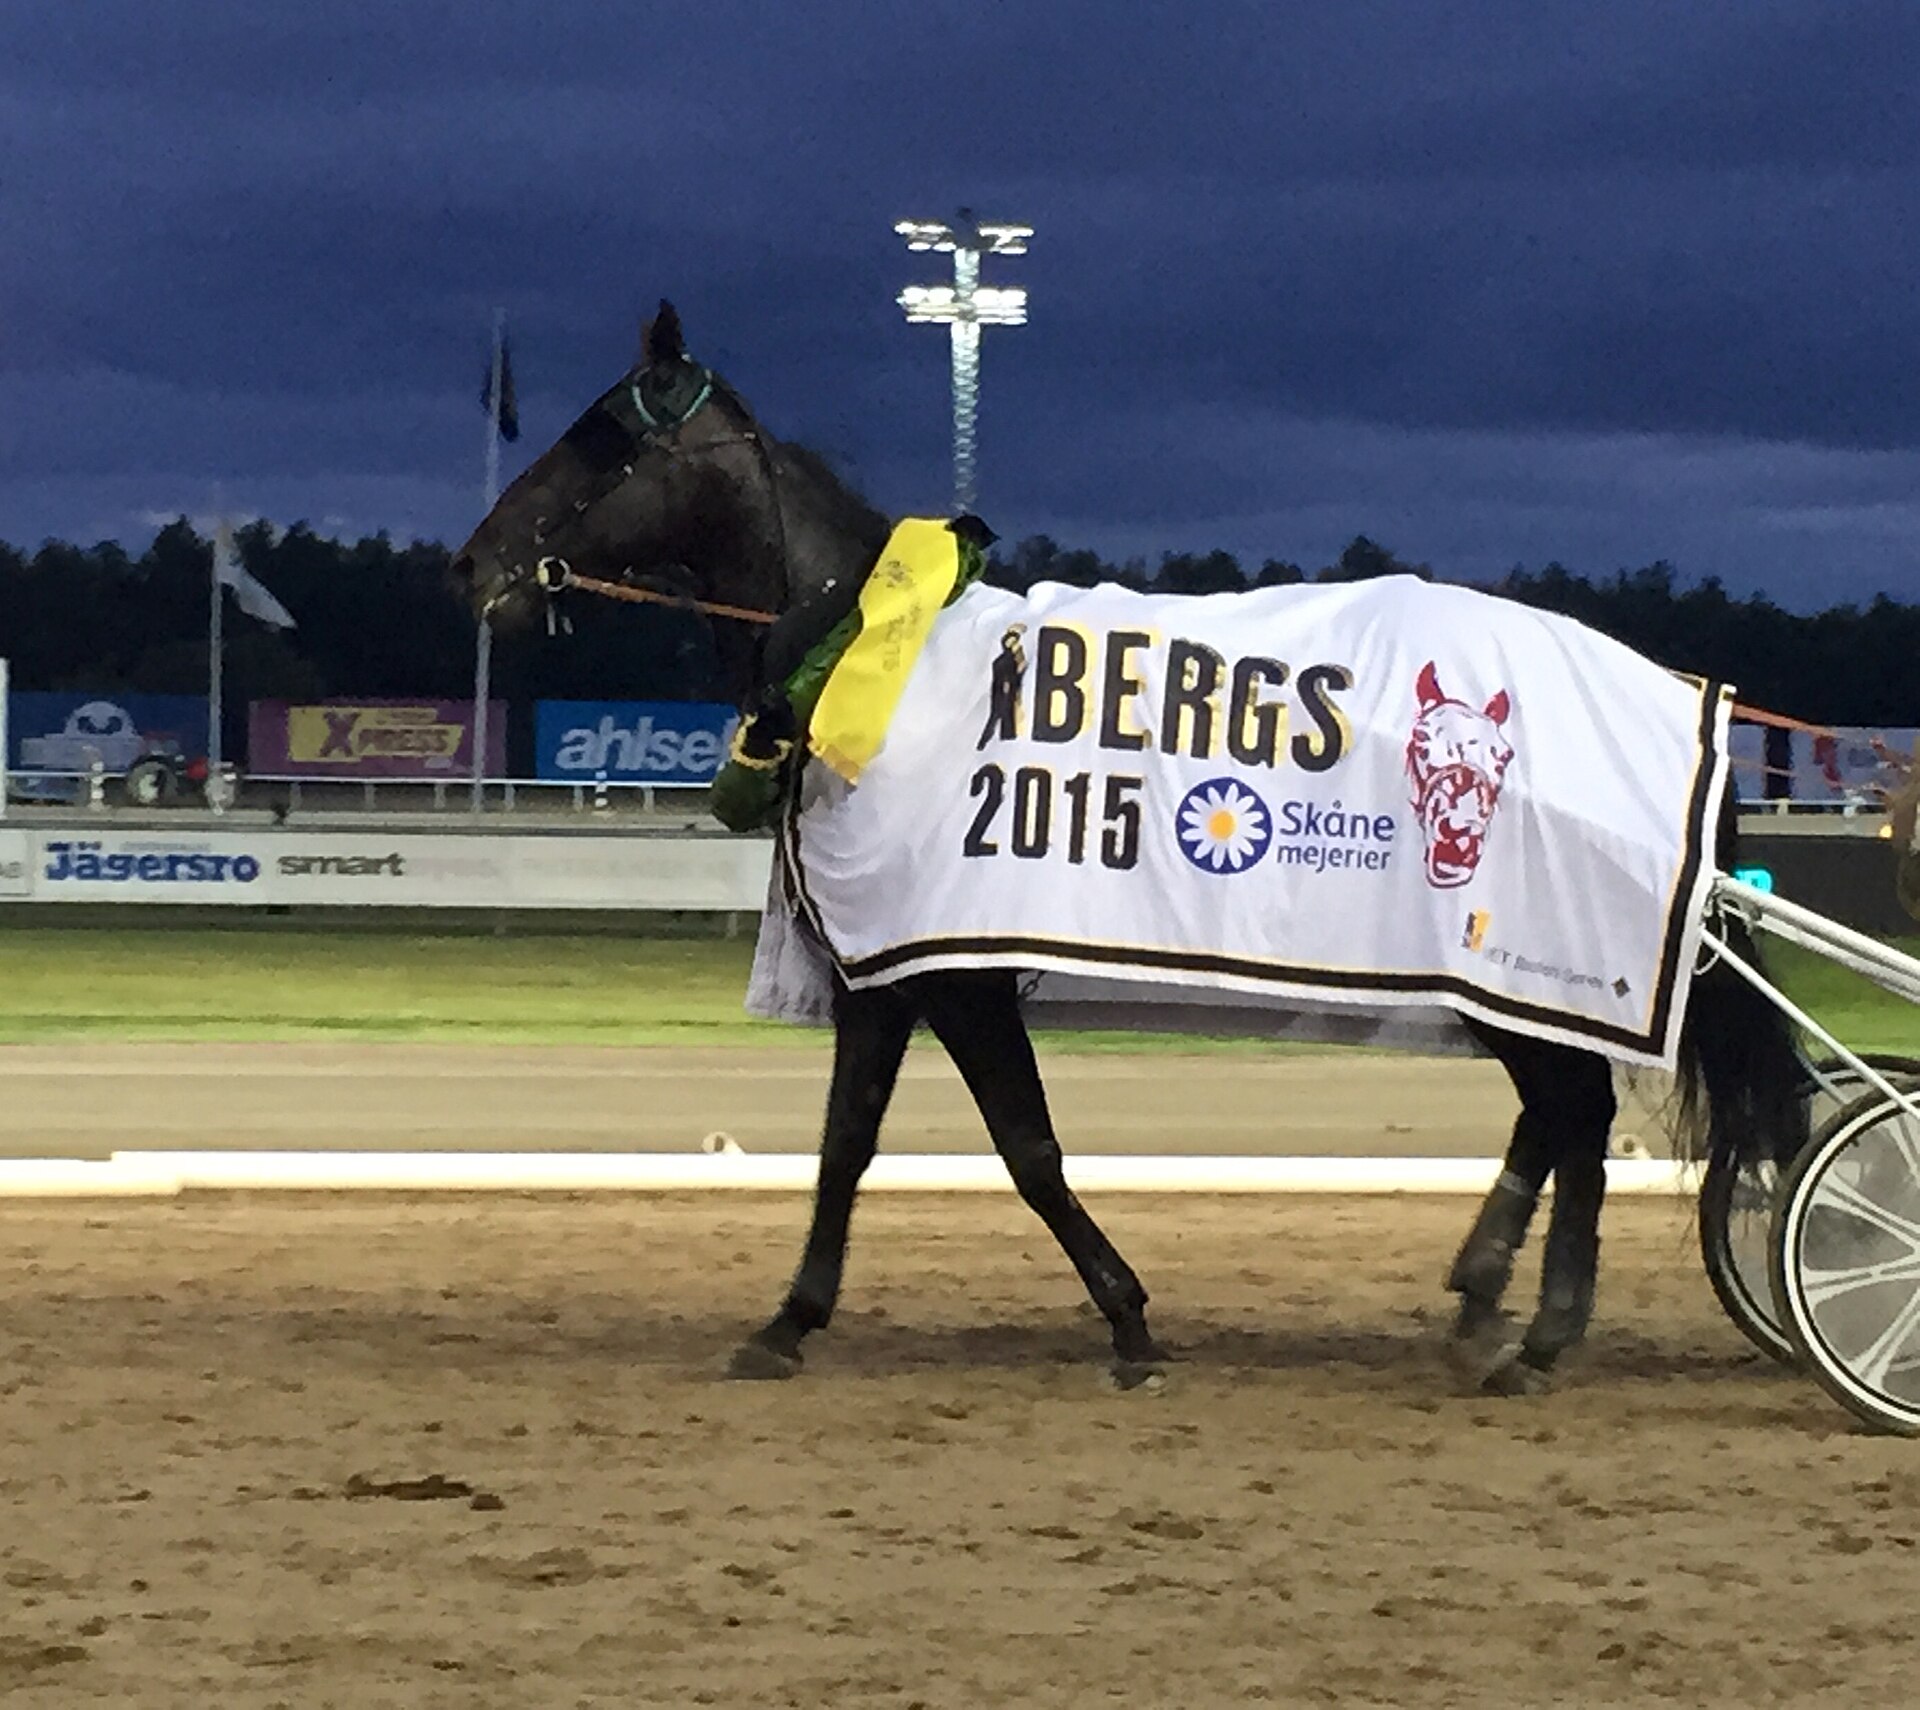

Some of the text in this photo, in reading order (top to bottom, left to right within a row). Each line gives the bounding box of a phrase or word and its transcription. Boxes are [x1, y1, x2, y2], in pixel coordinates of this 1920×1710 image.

[963, 763, 1144, 870] 2015
[1280, 800, 1395, 842] Skåne
[45, 841, 262, 883] Jägersro
[278, 852, 404, 877] smart
[1276, 844, 1391, 874] mejerier
